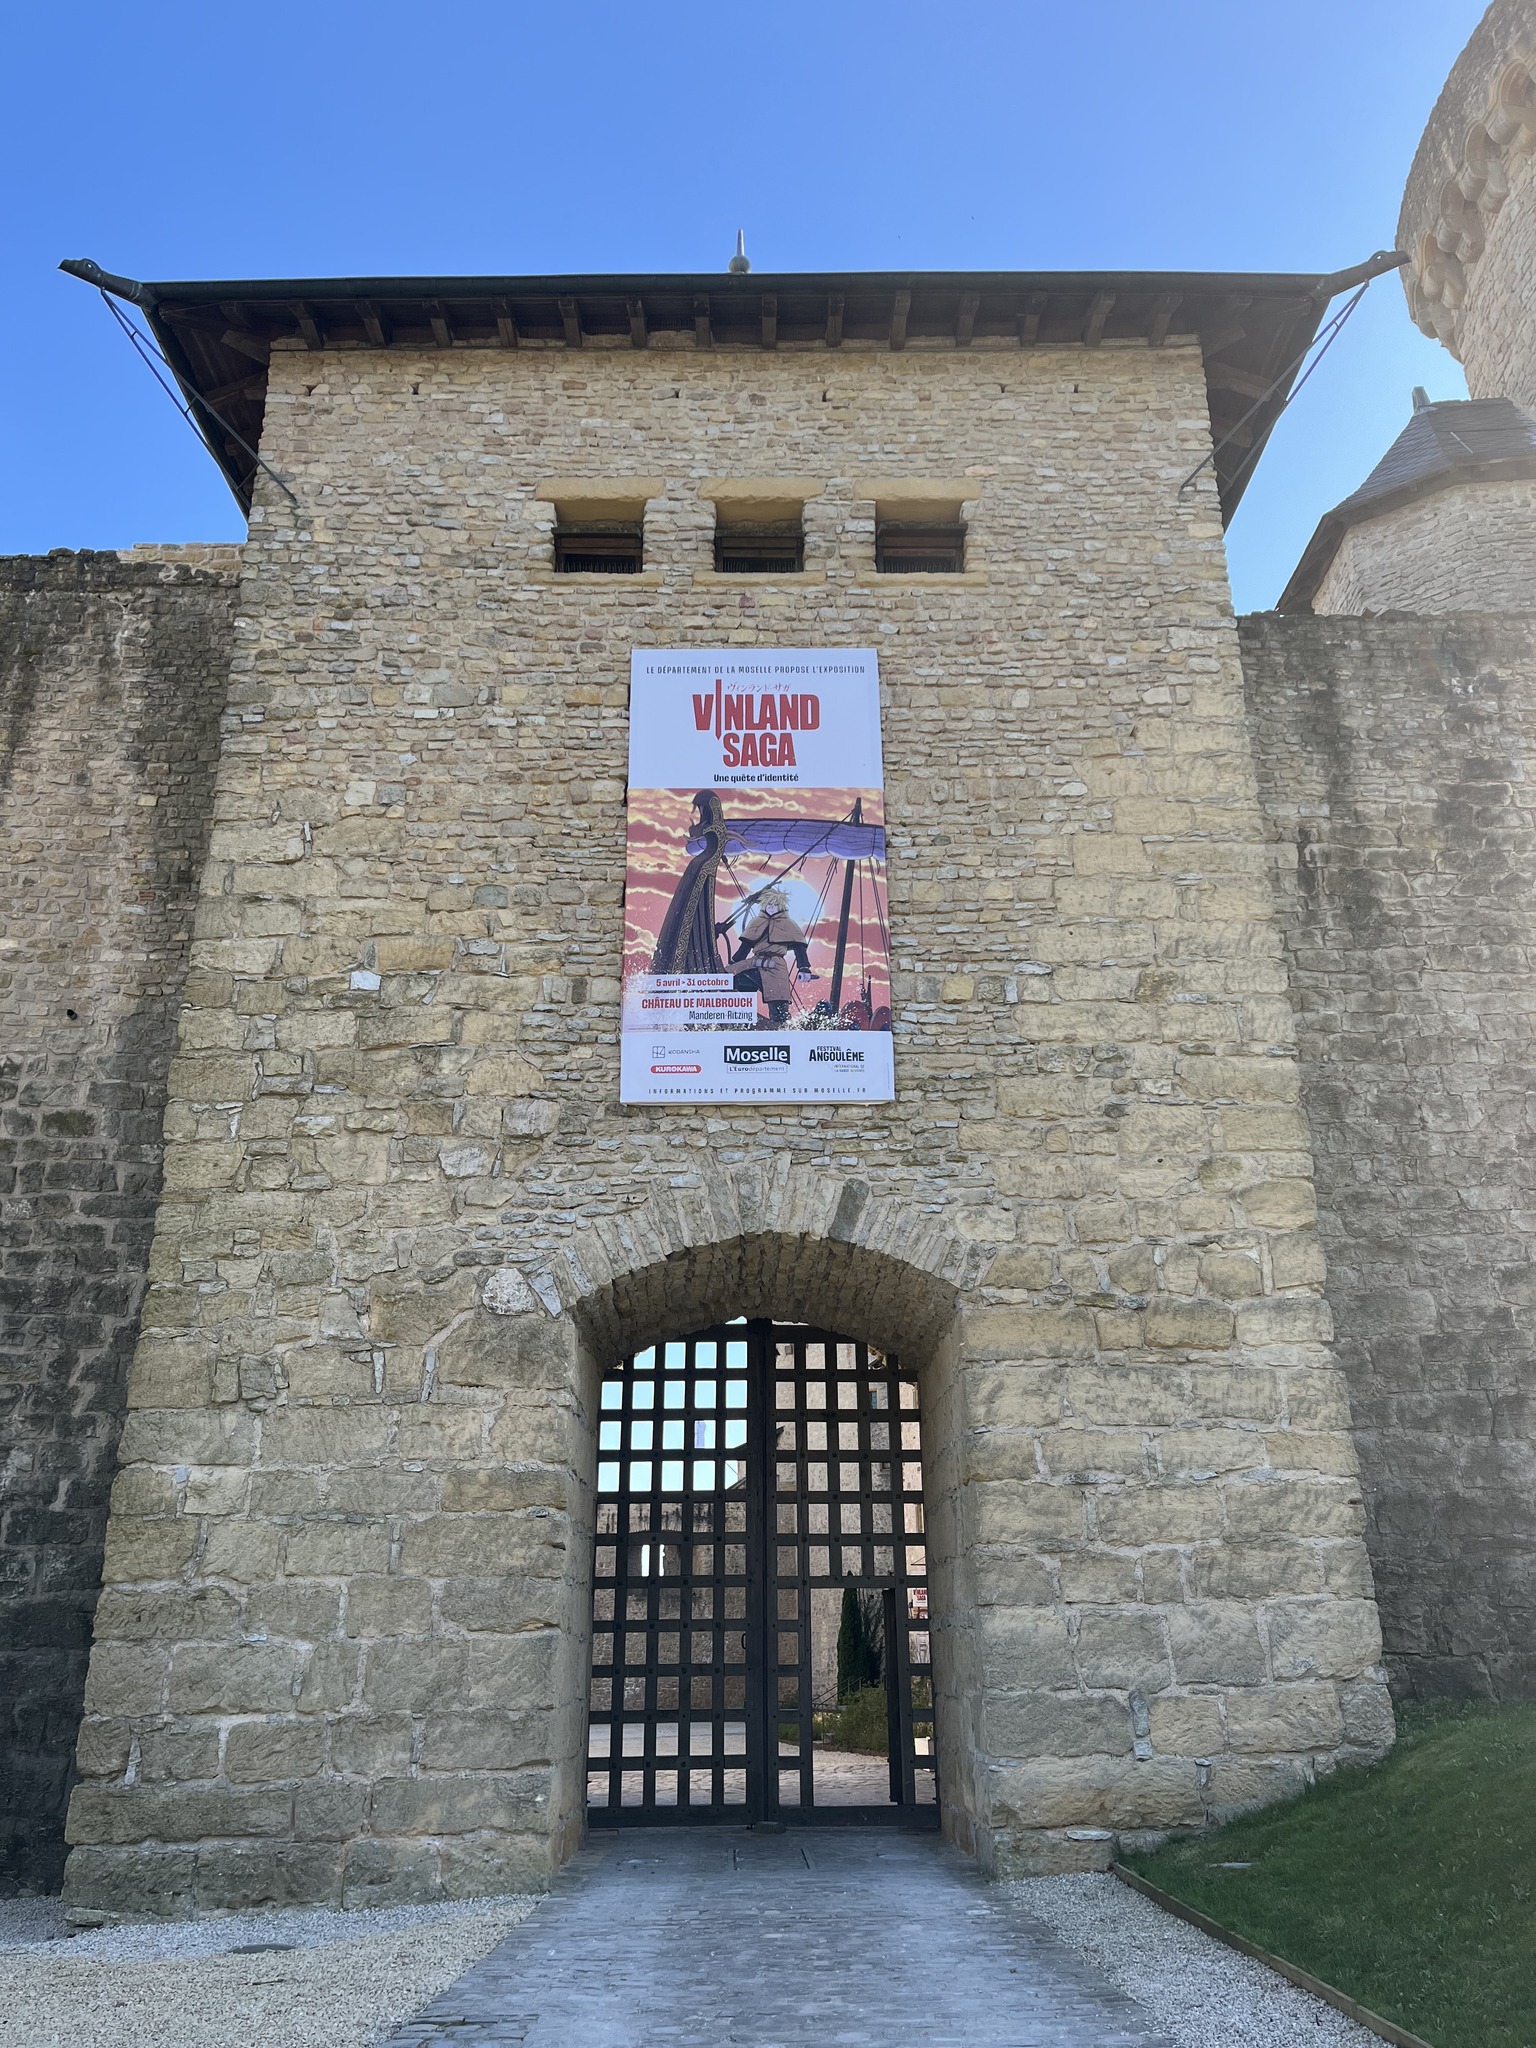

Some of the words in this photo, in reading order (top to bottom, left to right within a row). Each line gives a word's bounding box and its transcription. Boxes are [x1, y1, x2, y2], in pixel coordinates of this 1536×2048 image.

[646, 666, 655, 674] LE
[657, 665, 712, 674] DÉPARTEMENT
[714, 666, 724, 674] DE
[726, 666, 736, 674] LA
[738, 666, 772, 674] MOSELLE
[774, 665, 810, 674] PROPOSE
[812, 665, 865, 674] L'EXPOSITION
[692, 679, 820, 740] VINLAND
[722, 732, 797, 767] SAGA
[713, 774, 730, 782] Une
[730, 773, 756, 783] quête
[757, 773, 799, 782] d'identité
[656, 979, 662, 987] 5
[662, 979, 681, 987] avril
[686, 978, 695, 986] 31
[697, 978, 729, 986] octobre
[642, 997, 682, 1009] CHÂTEAU
[683, 998, 696, 1008] DE
[697, 997, 753, 1008] MALBROUCK
[688, 1010, 753, 1021] Manderen-Ritzing
[726, 1046, 788, 1062] Moselle
[809, 1048, 865, 1062] ANGOULÊME
[734, 1087, 787, 1095] PROGRAMME
